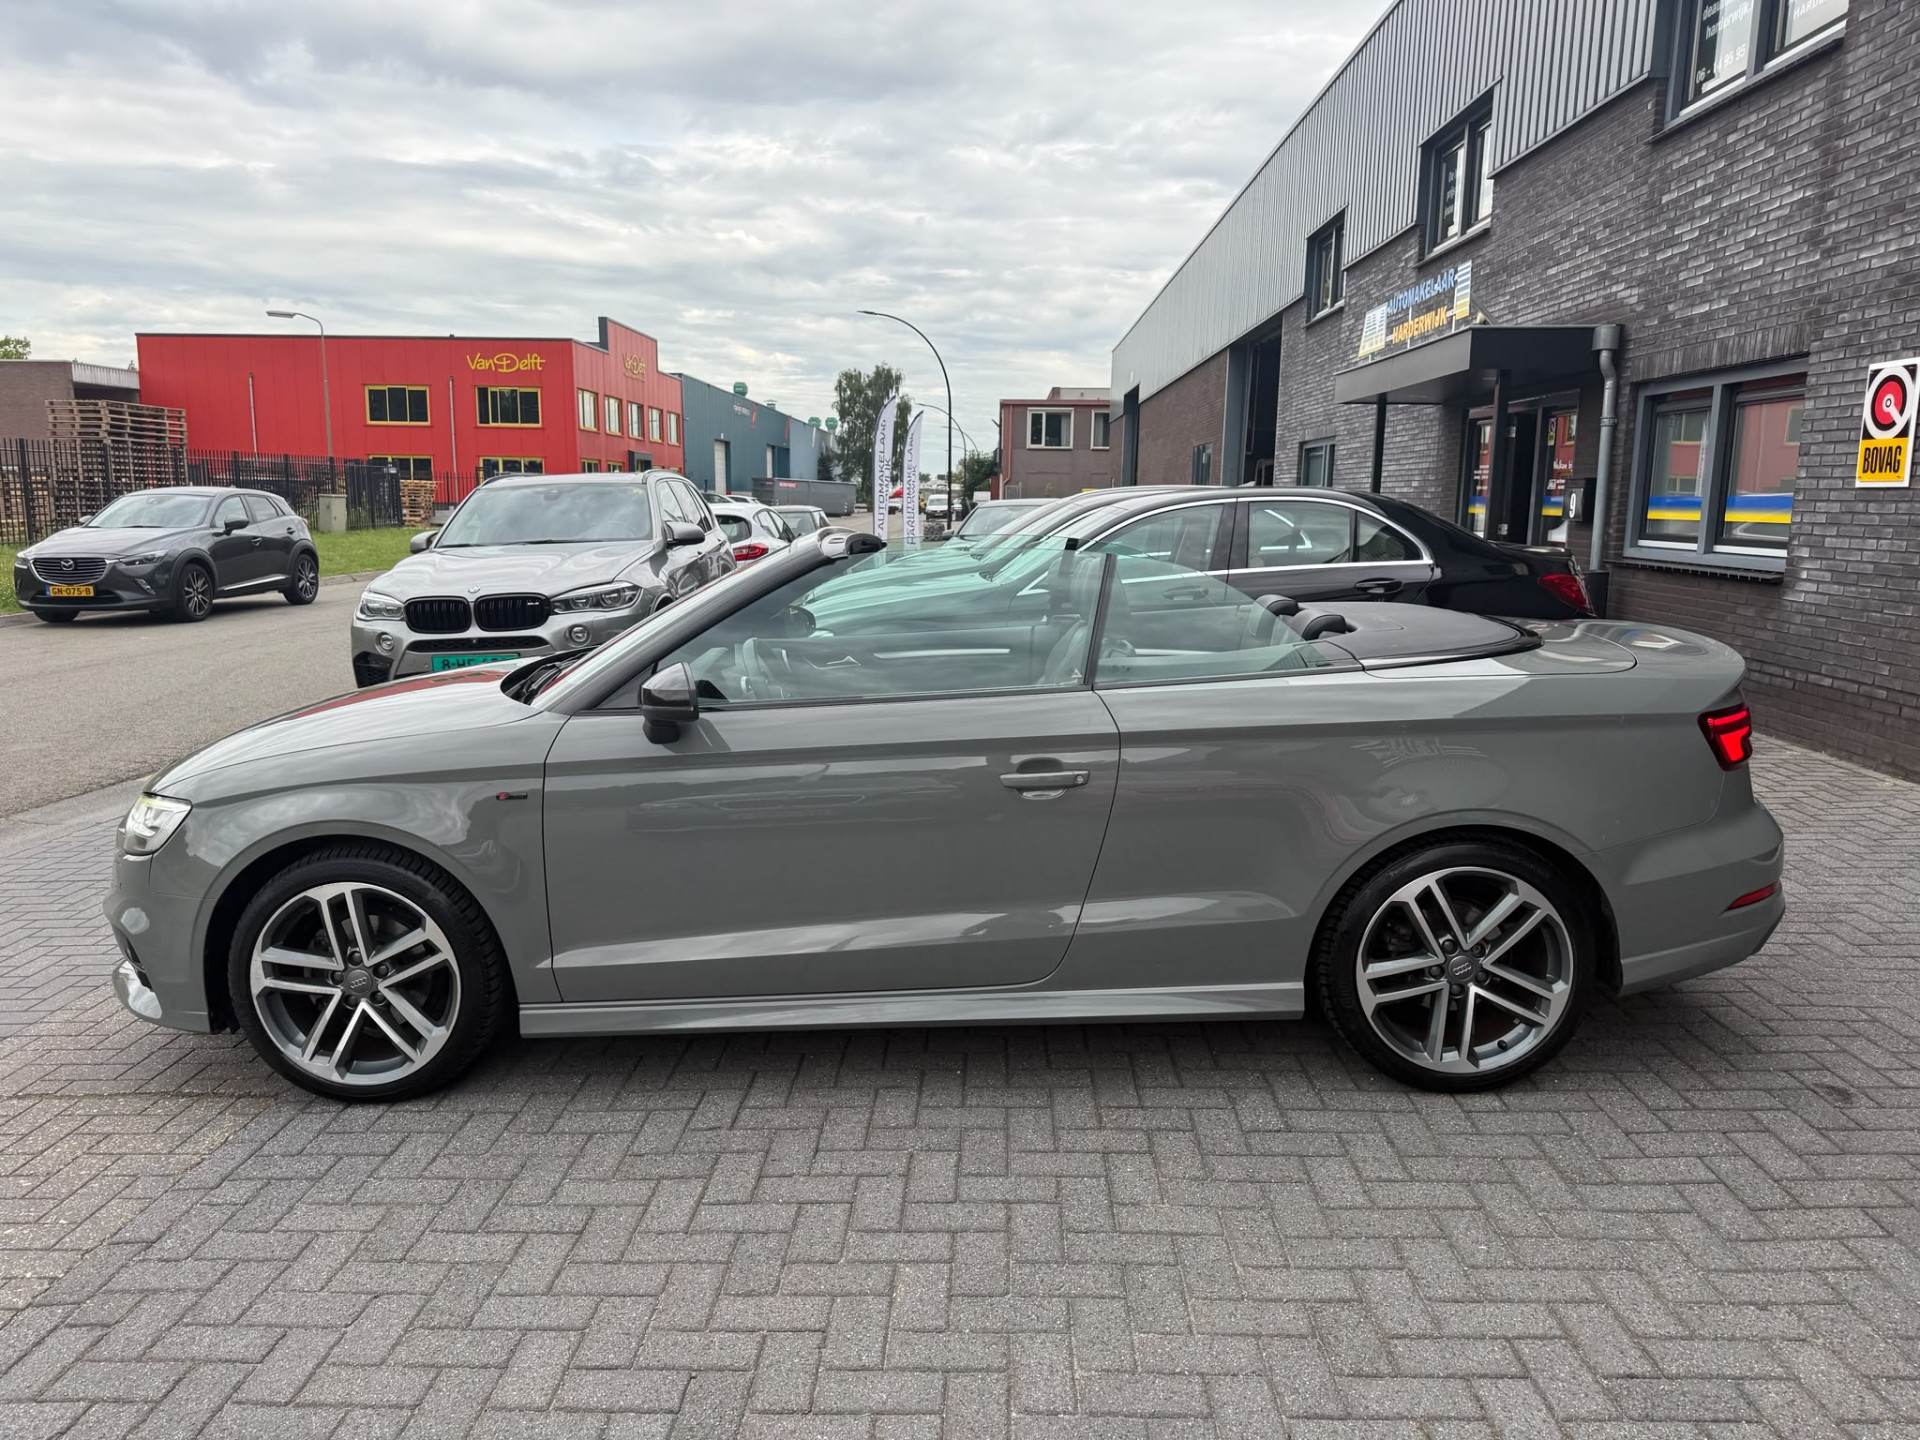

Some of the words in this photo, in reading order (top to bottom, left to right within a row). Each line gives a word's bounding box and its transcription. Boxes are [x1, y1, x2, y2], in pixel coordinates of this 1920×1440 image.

[1387, 268, 1455, 316] AUTOMAKELAAR
[1392, 306, 1447, 344] HARDERWIJK
[1862, 445, 1902, 474] BOVAG
[1569, 493, 1576, 518] 9
[51, 587, 92, 596] GN-075-B
